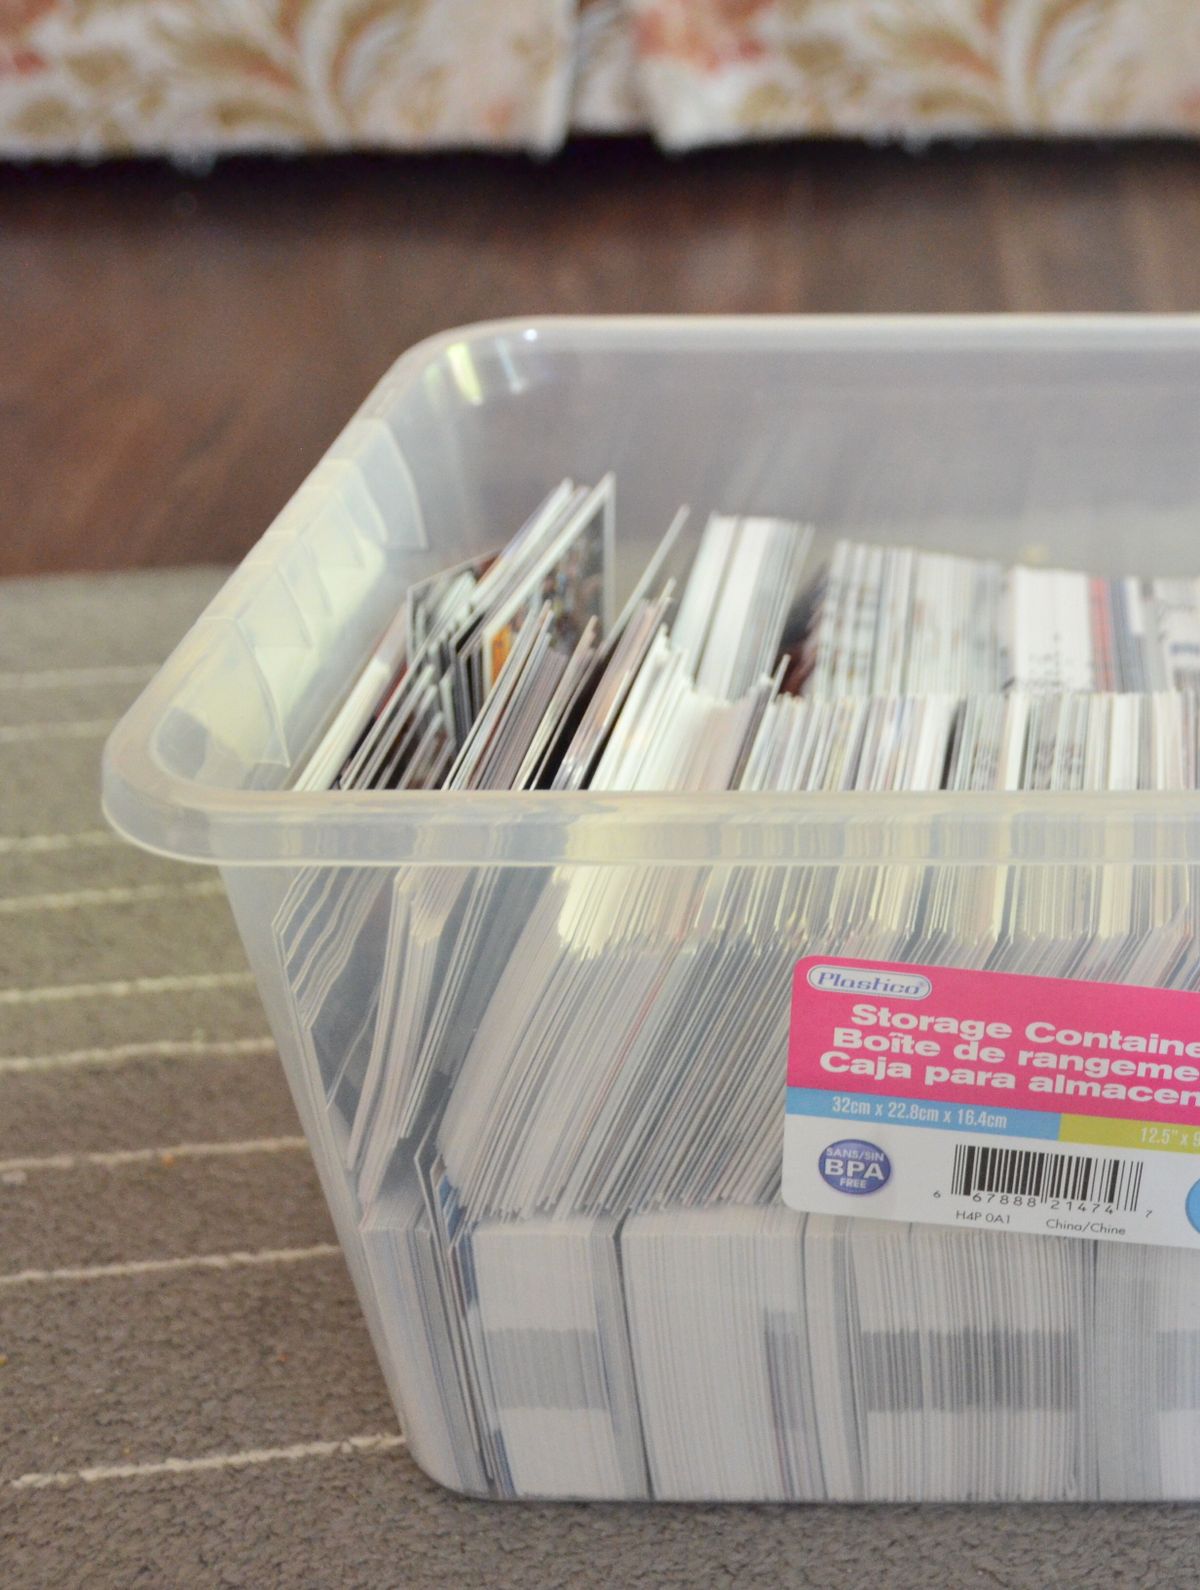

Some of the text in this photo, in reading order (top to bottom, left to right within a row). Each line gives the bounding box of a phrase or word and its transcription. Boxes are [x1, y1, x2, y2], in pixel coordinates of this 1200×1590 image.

[818, 971, 921, 995] Plastico
[851, 1004, 1012, 1041] Storage
[833, 1027, 941, 1056] Boîte
[953, 1041, 1005, 1063] de
[820, 1051, 912, 1080] Caja
[924, 1065, 1016, 1089] para
[832, 1096, 1008, 1128] 32cm x 22.8cm x 16.4cm
[1180, 1134, 1188, 1146] x
[826, 1147, 885, 1161] SANS/SIN
[824, 1158, 884, 1181] BPA
[839, 1177, 868, 1189] FREE
[933, 1190, 1153, 1218] 6 67888 21474 7
[955, 1210, 982, 1221] H4P
[1045, 1218, 1127, 1236] China/Chine
